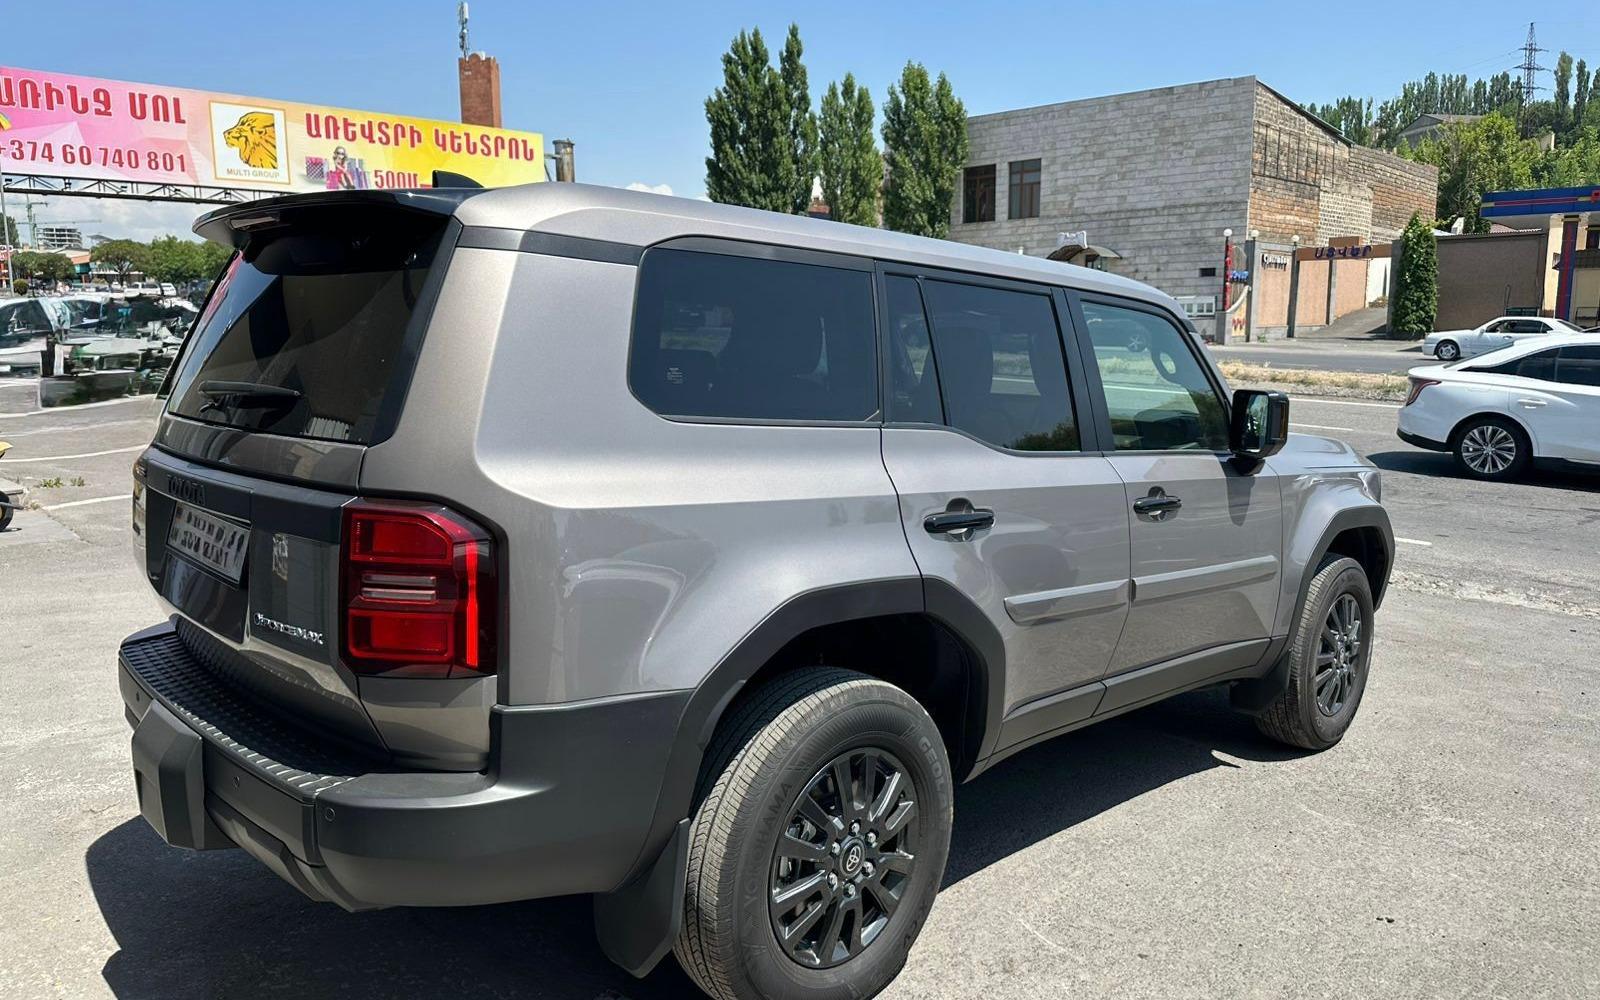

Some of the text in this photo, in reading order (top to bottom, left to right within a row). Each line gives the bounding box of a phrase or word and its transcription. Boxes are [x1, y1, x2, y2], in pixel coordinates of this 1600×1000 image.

[128, 92, 186, 124] ՄՈԼ
[305, 113, 534, 161] ԱՌԵՎՏՐԻ ԿԵՆՏՐՈՆ
[62, 144, 92, 166] 60
[99, 147, 140, 169] 740
[147, 151, 186, 172] 801
[227, 168, 280, 179] MULTI GROUP
[167, 475, 206, 507] TOYOTA
